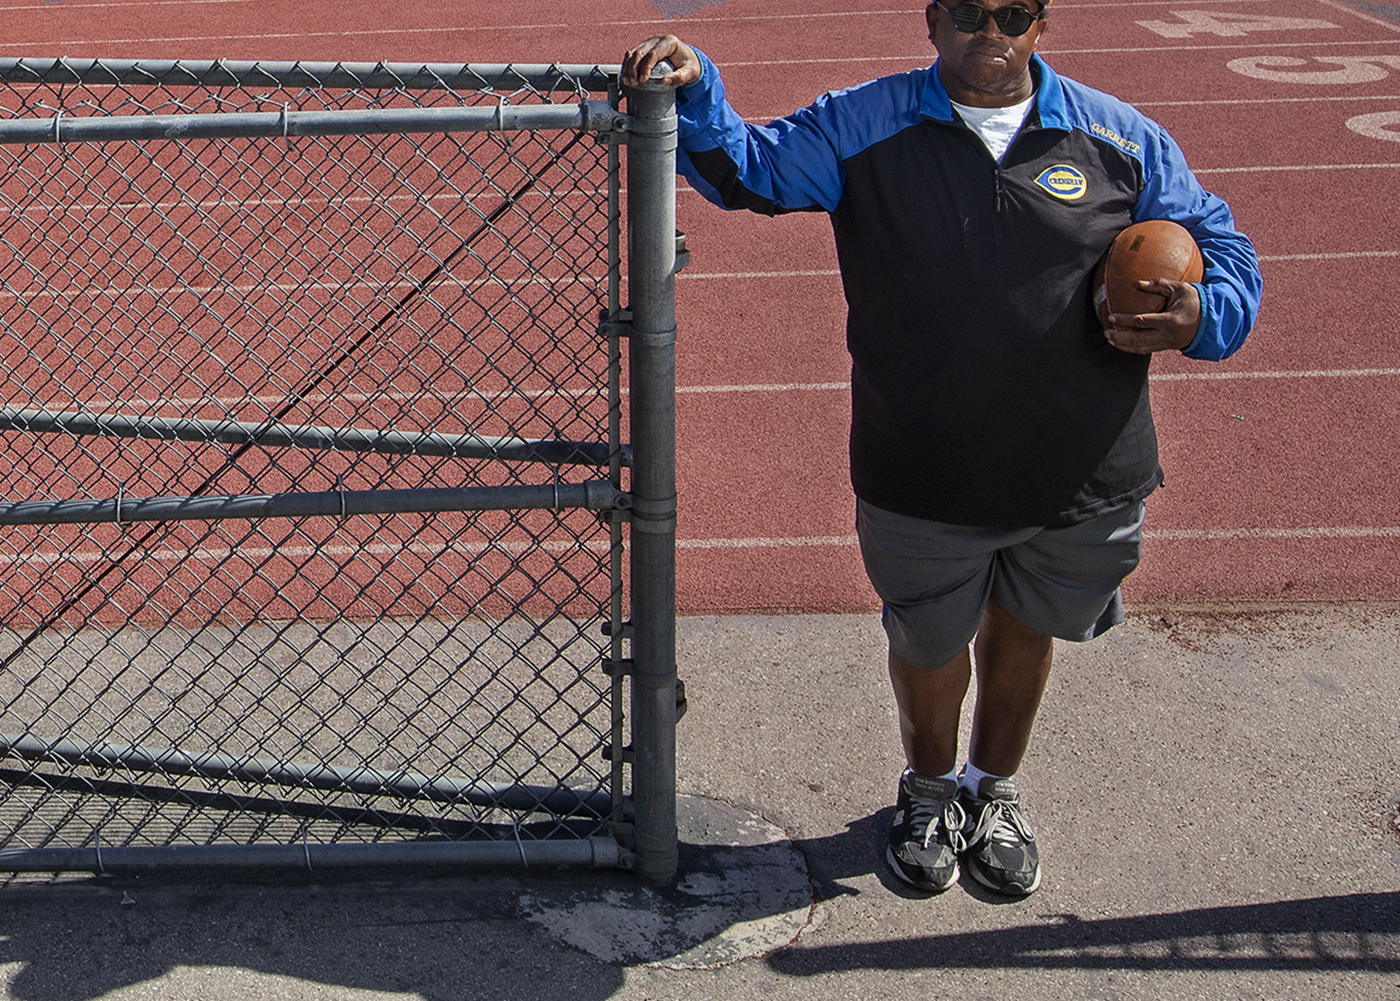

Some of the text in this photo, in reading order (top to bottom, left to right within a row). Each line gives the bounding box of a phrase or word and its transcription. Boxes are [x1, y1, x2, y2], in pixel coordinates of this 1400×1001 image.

[1134, 9, 1343, 39] 4
[1226, 55, 1400, 85] 5
[1091, 122, 1141, 154] GARRETT
